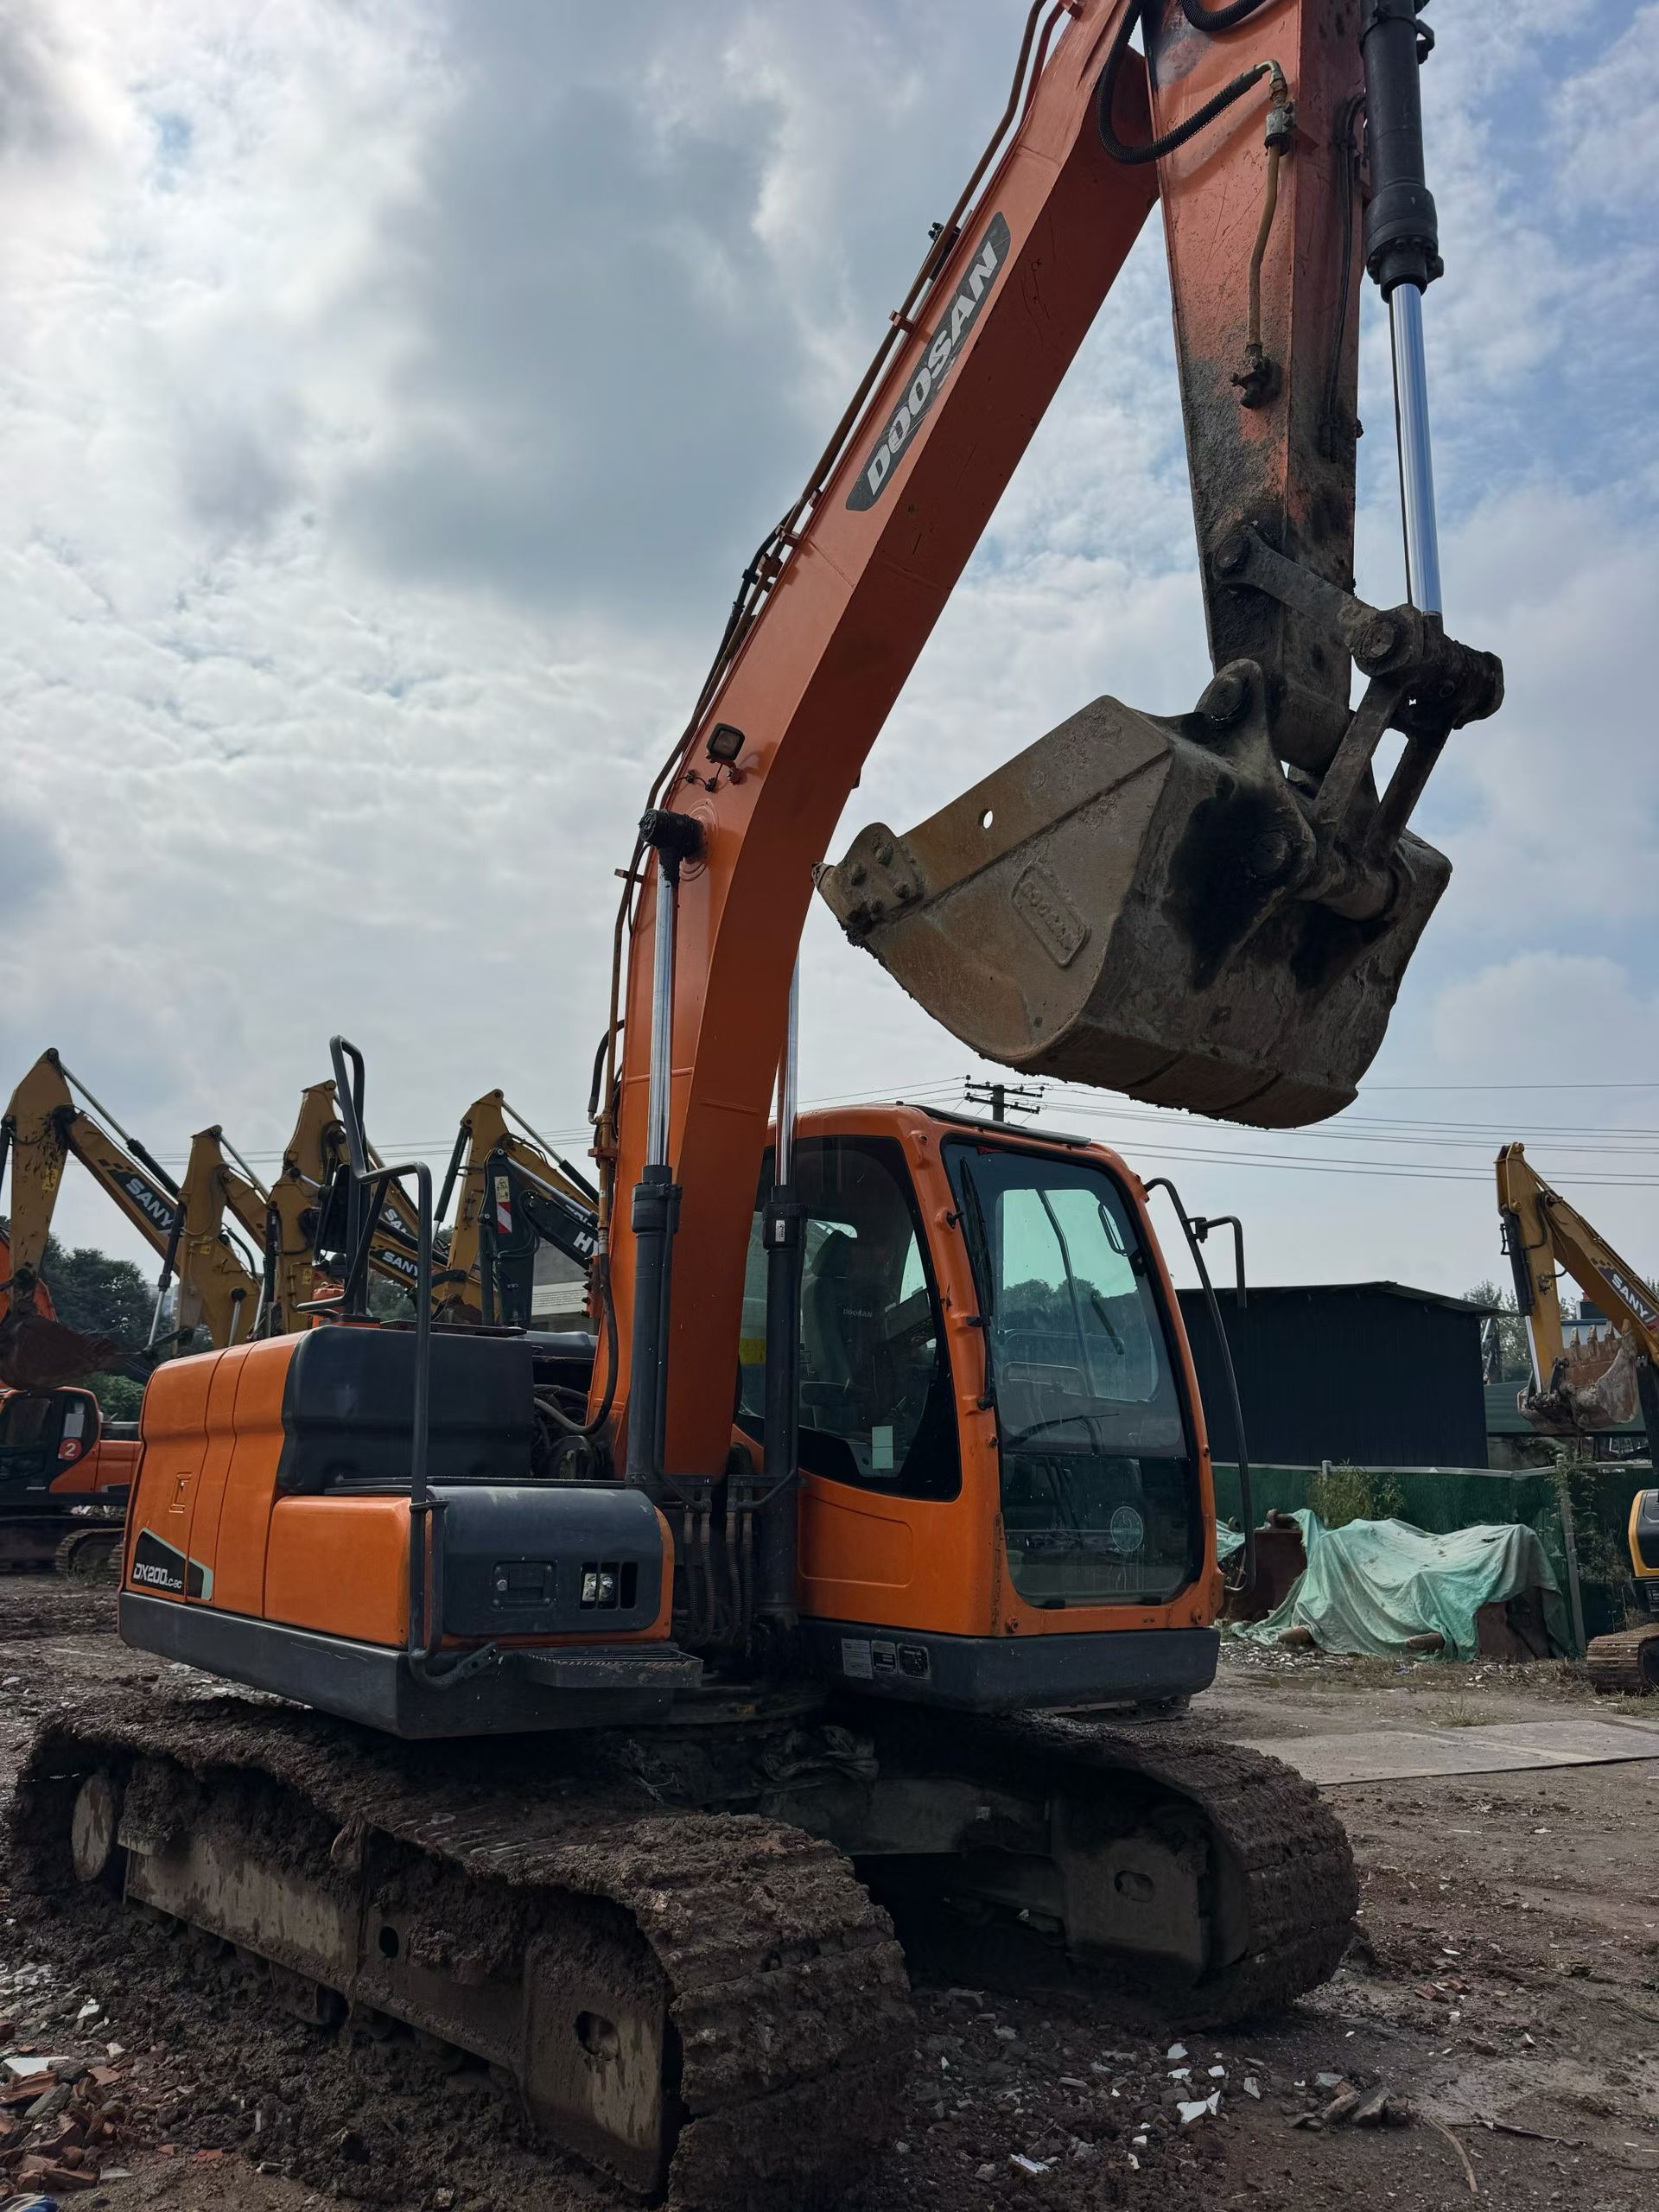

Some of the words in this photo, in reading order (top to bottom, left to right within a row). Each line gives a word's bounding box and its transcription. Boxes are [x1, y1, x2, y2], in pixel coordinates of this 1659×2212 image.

[867, 241, 998, 495] DOOSAN
[125, 1178, 173, 1227] SANY
[1611, 1274, 1649, 1319] SANY
[65, 1442, 77, 1457] 2
